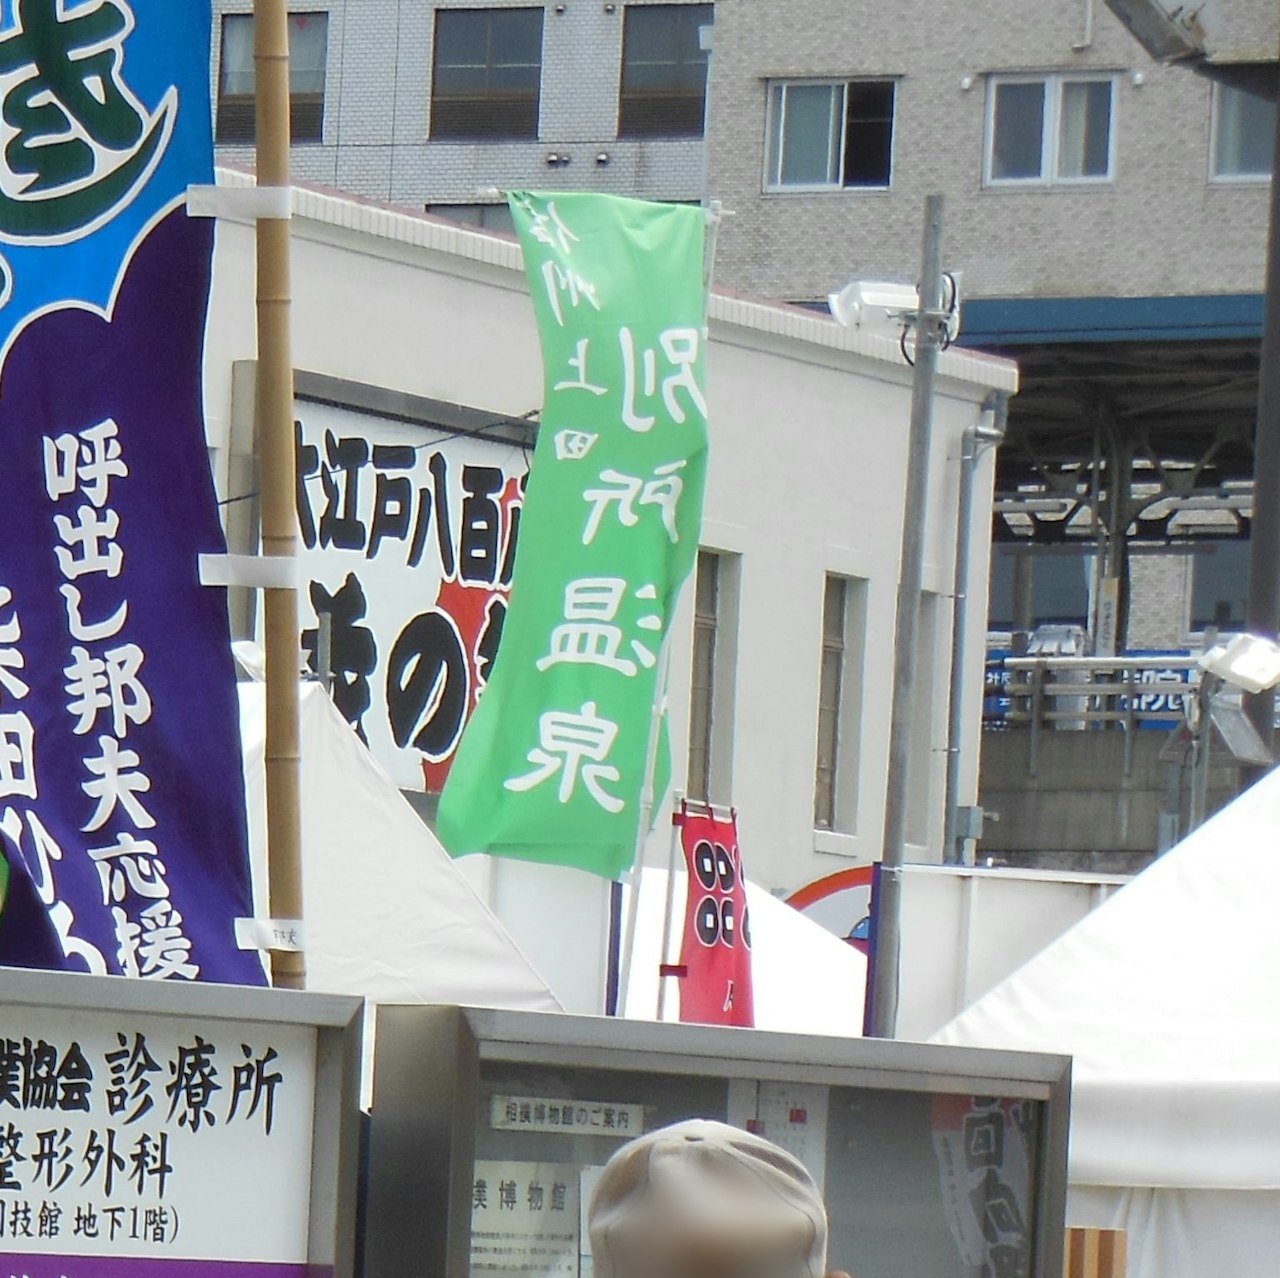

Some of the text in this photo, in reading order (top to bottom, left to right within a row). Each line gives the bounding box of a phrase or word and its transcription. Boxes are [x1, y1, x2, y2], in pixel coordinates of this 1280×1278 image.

[43, 418, 200, 981] 呼出し邦夫応援
[104, 1031, 284, 1135] 診療所
